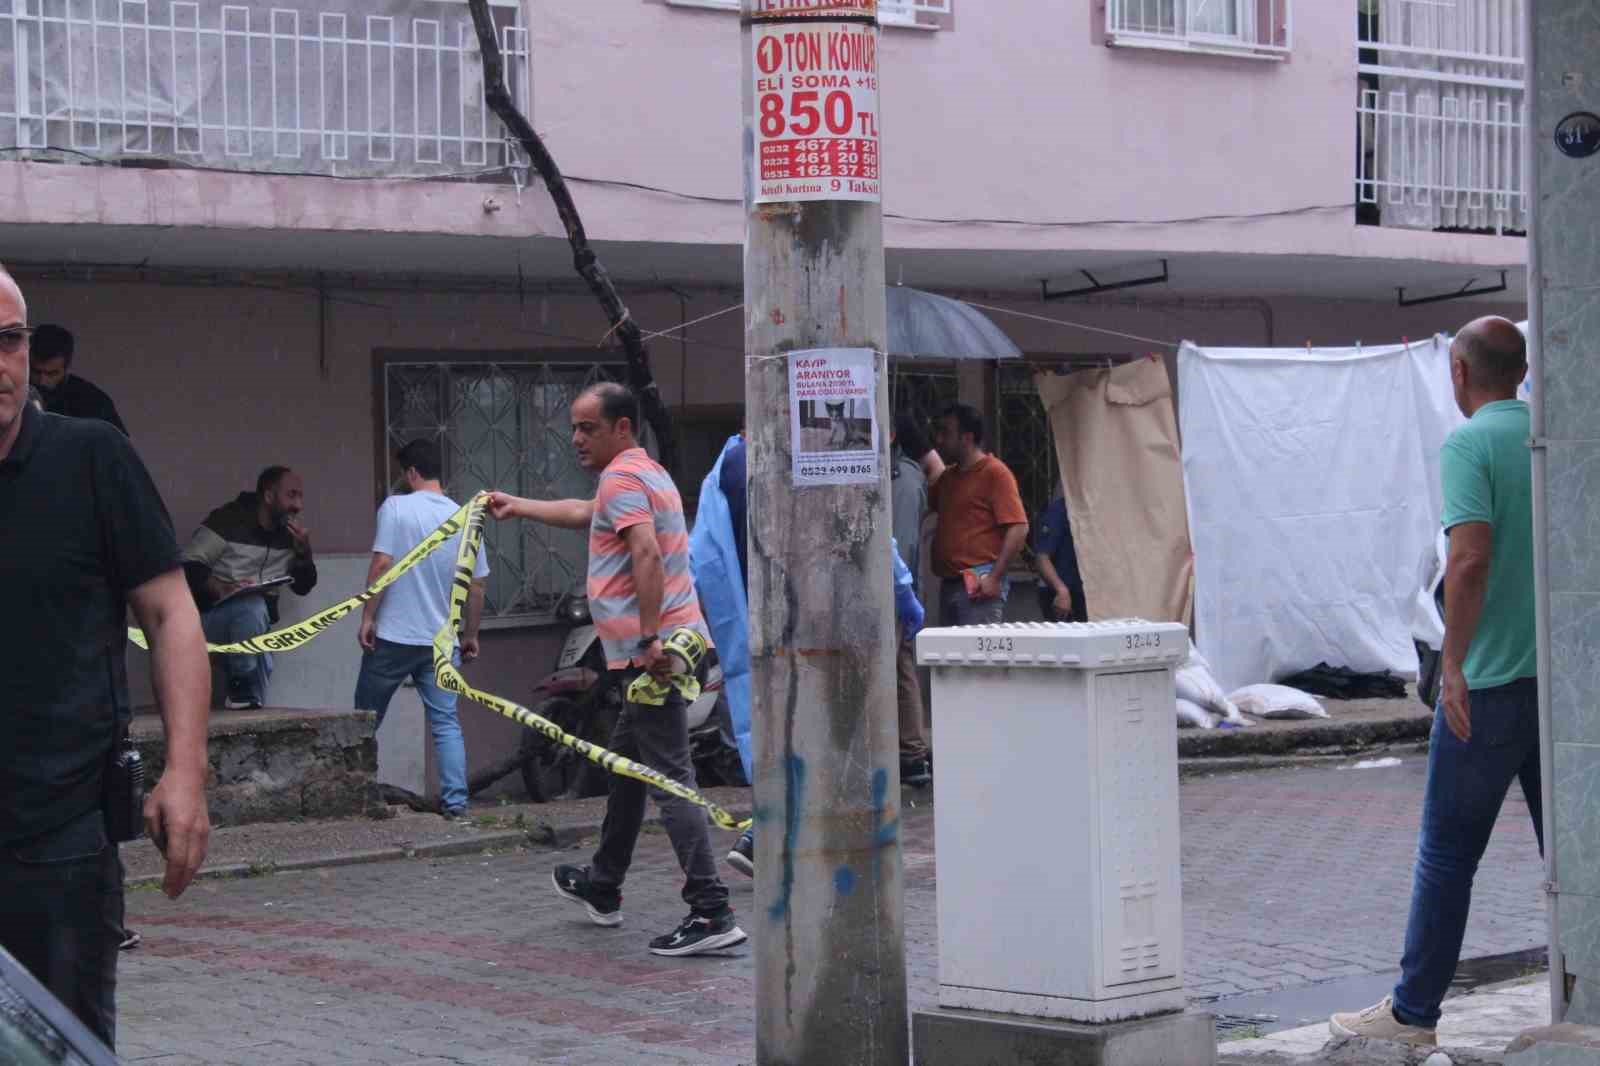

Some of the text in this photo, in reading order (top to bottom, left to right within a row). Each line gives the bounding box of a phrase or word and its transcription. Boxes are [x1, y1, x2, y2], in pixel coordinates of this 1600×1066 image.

[784, 32, 821, 72] TON
[828, 24, 876, 73] KÖMÜR
[757, 74, 784, 91] ELİ
[792, 75, 850, 89] SOMA
[760, 90, 877, 138] 850 TL
[794, 140, 831, 151] 467
[838, 140, 857, 150] 21
[863, 141, 876, 152] 21
[795, 152, 830, 163] 461
[838, 152, 858, 163] 20
[796, 165, 832, 176] 162
[838, 165, 858, 175] 37
[831, 179, 841, 191] 9
[796, 359, 827, 369] KAYIP
[796, 369, 850, 380] ARANIYOR
